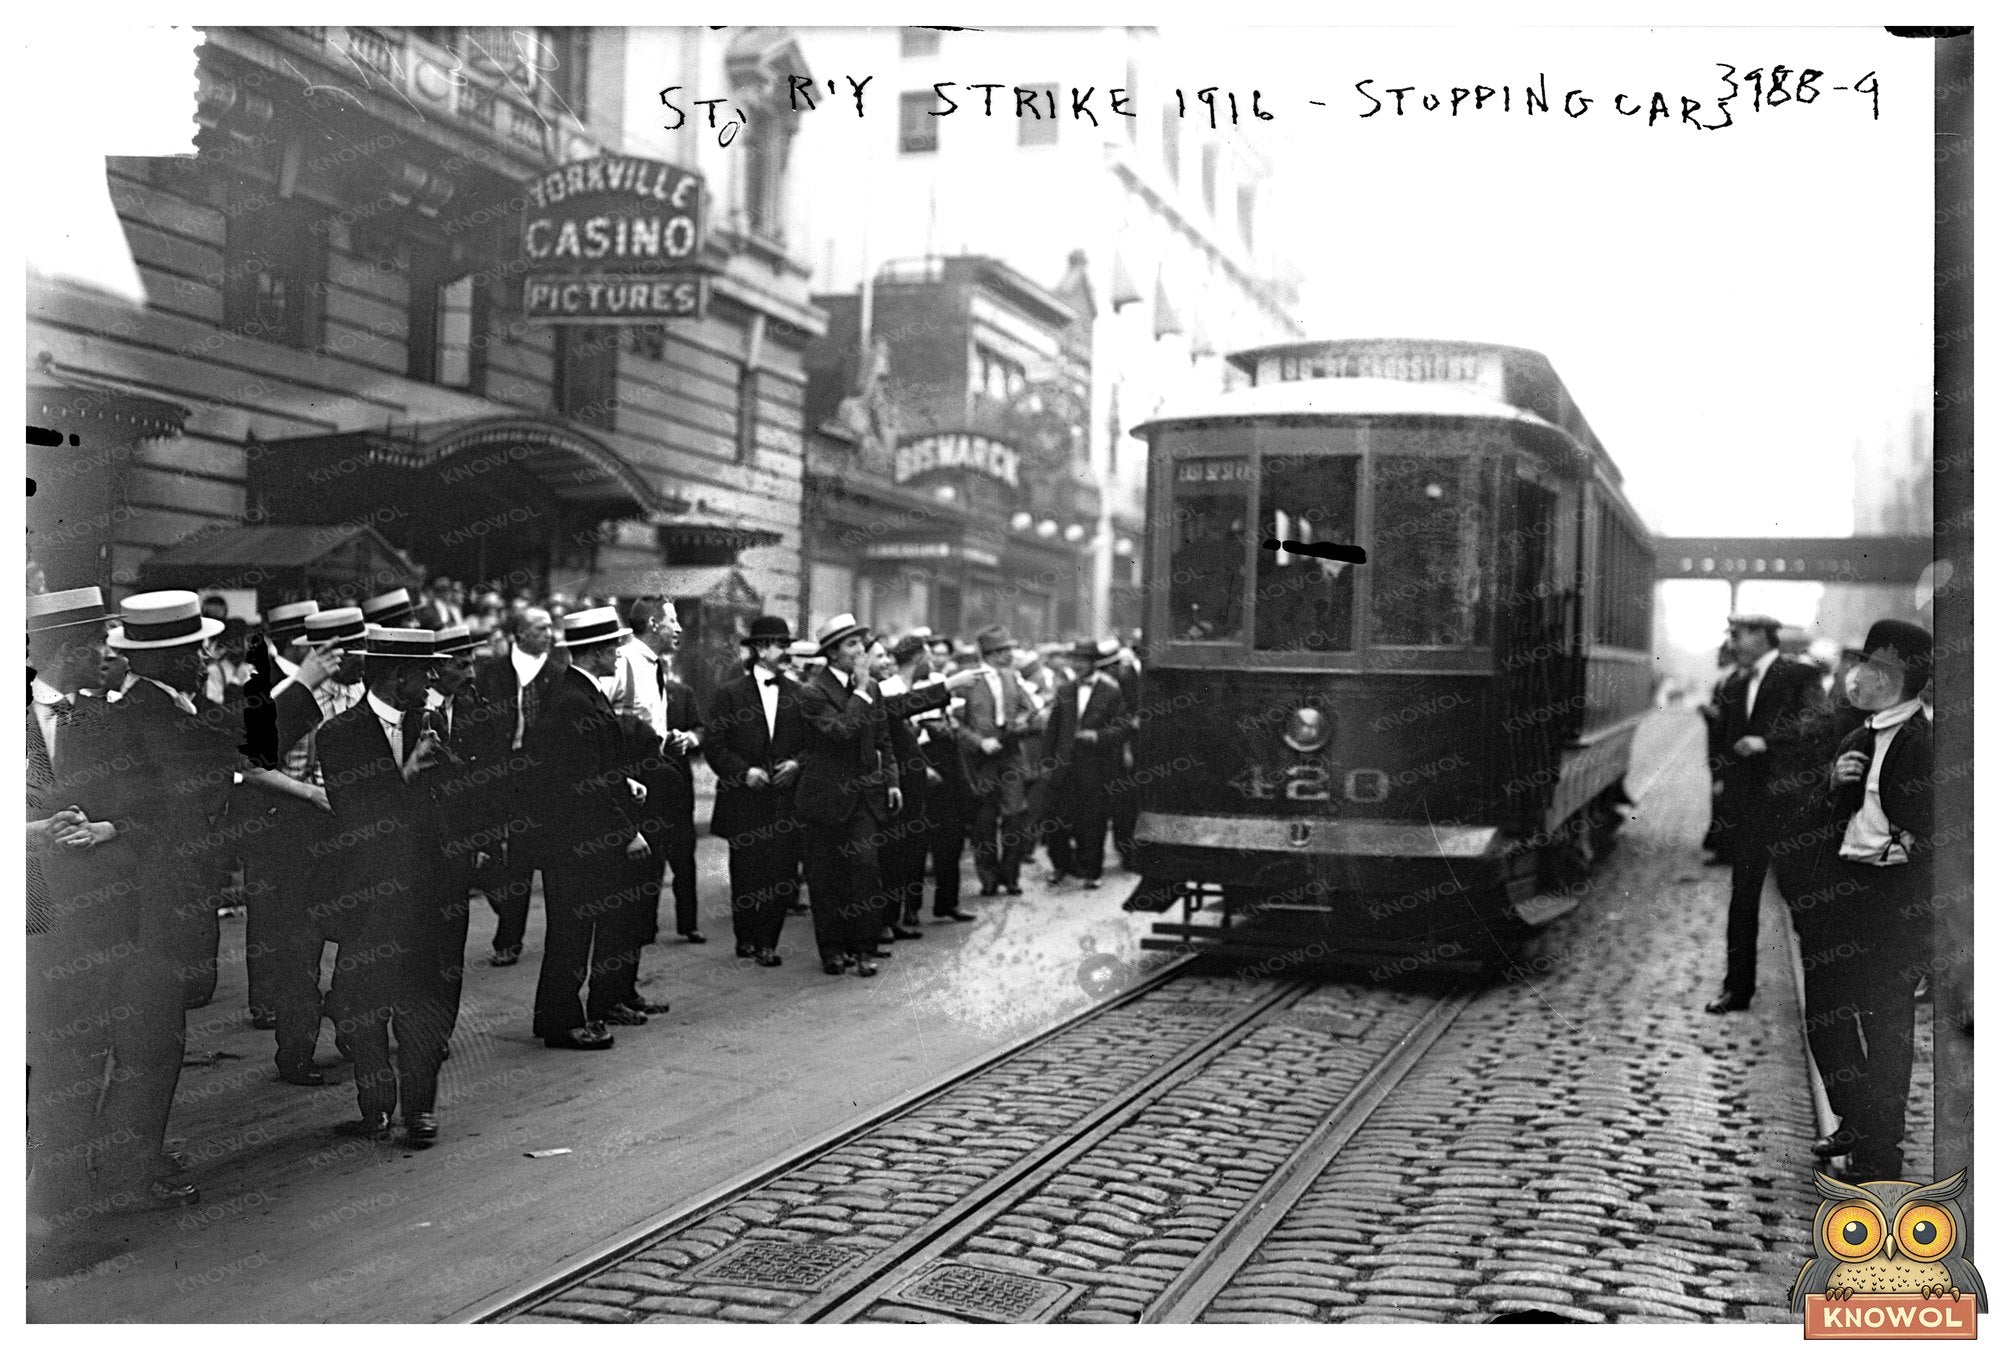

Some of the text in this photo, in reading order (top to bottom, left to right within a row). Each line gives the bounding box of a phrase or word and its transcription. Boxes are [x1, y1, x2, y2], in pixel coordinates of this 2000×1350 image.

[928, 81, 1137, 128] STRIKE
[1175, 86, 1274, 129] 1916
[1355, 72, 1594, 119] STOPPING
[529, 159, 698, 209] YORKVILLE
[526, 215, 695, 259] CASINO
[530, 283, 697, 313] PICTURES
